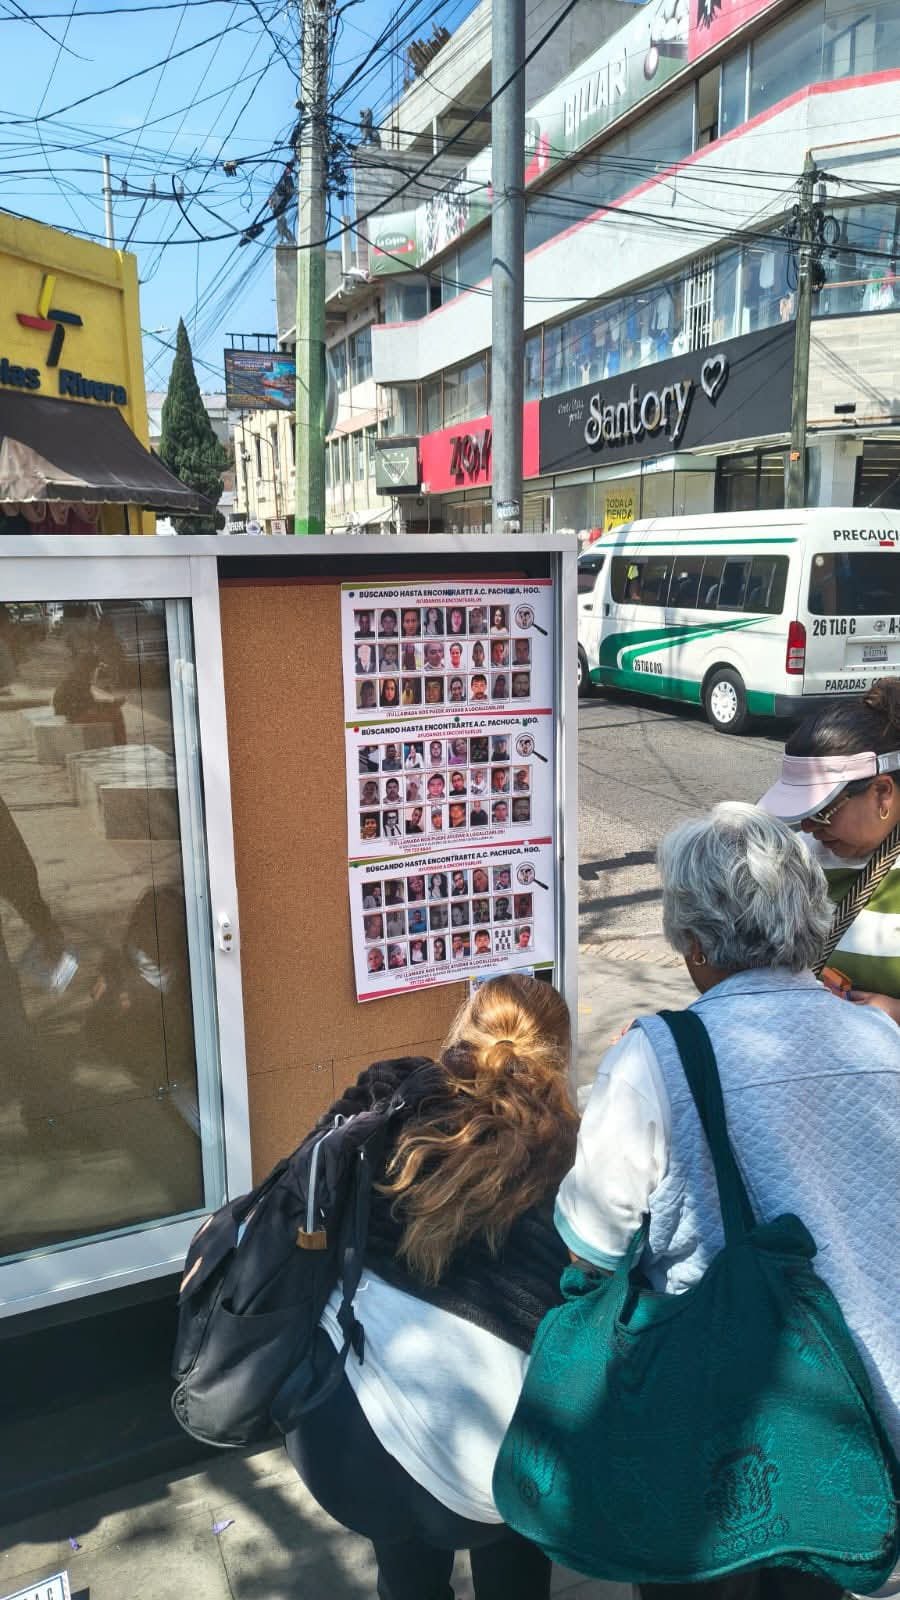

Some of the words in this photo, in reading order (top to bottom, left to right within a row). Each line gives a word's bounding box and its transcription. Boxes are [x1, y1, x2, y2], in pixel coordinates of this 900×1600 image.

[563, 57, 627, 137] BILLAR
[59, 368, 128, 406] Rivera
[584, 378, 693, 446] Santory
[606, 498, 623, 508] TODA
[624, 497, 633, 508] LA
[606, 508, 632, 520] TIENDA
[400, 589, 423, 598] HASTA
[813, 619, 827, 636] 26
[829, 618, 847, 635] TLG
[849, 618, 856, 635] C
[825, 678, 867, 691] PARADAS
[401, 725, 424, 733] HASTA
[424, 721, 473, 731] ENCONTRARTE
[405, 858, 426, 868] HASTA
[427, 852, 476, 865] ENCONTRARTE
